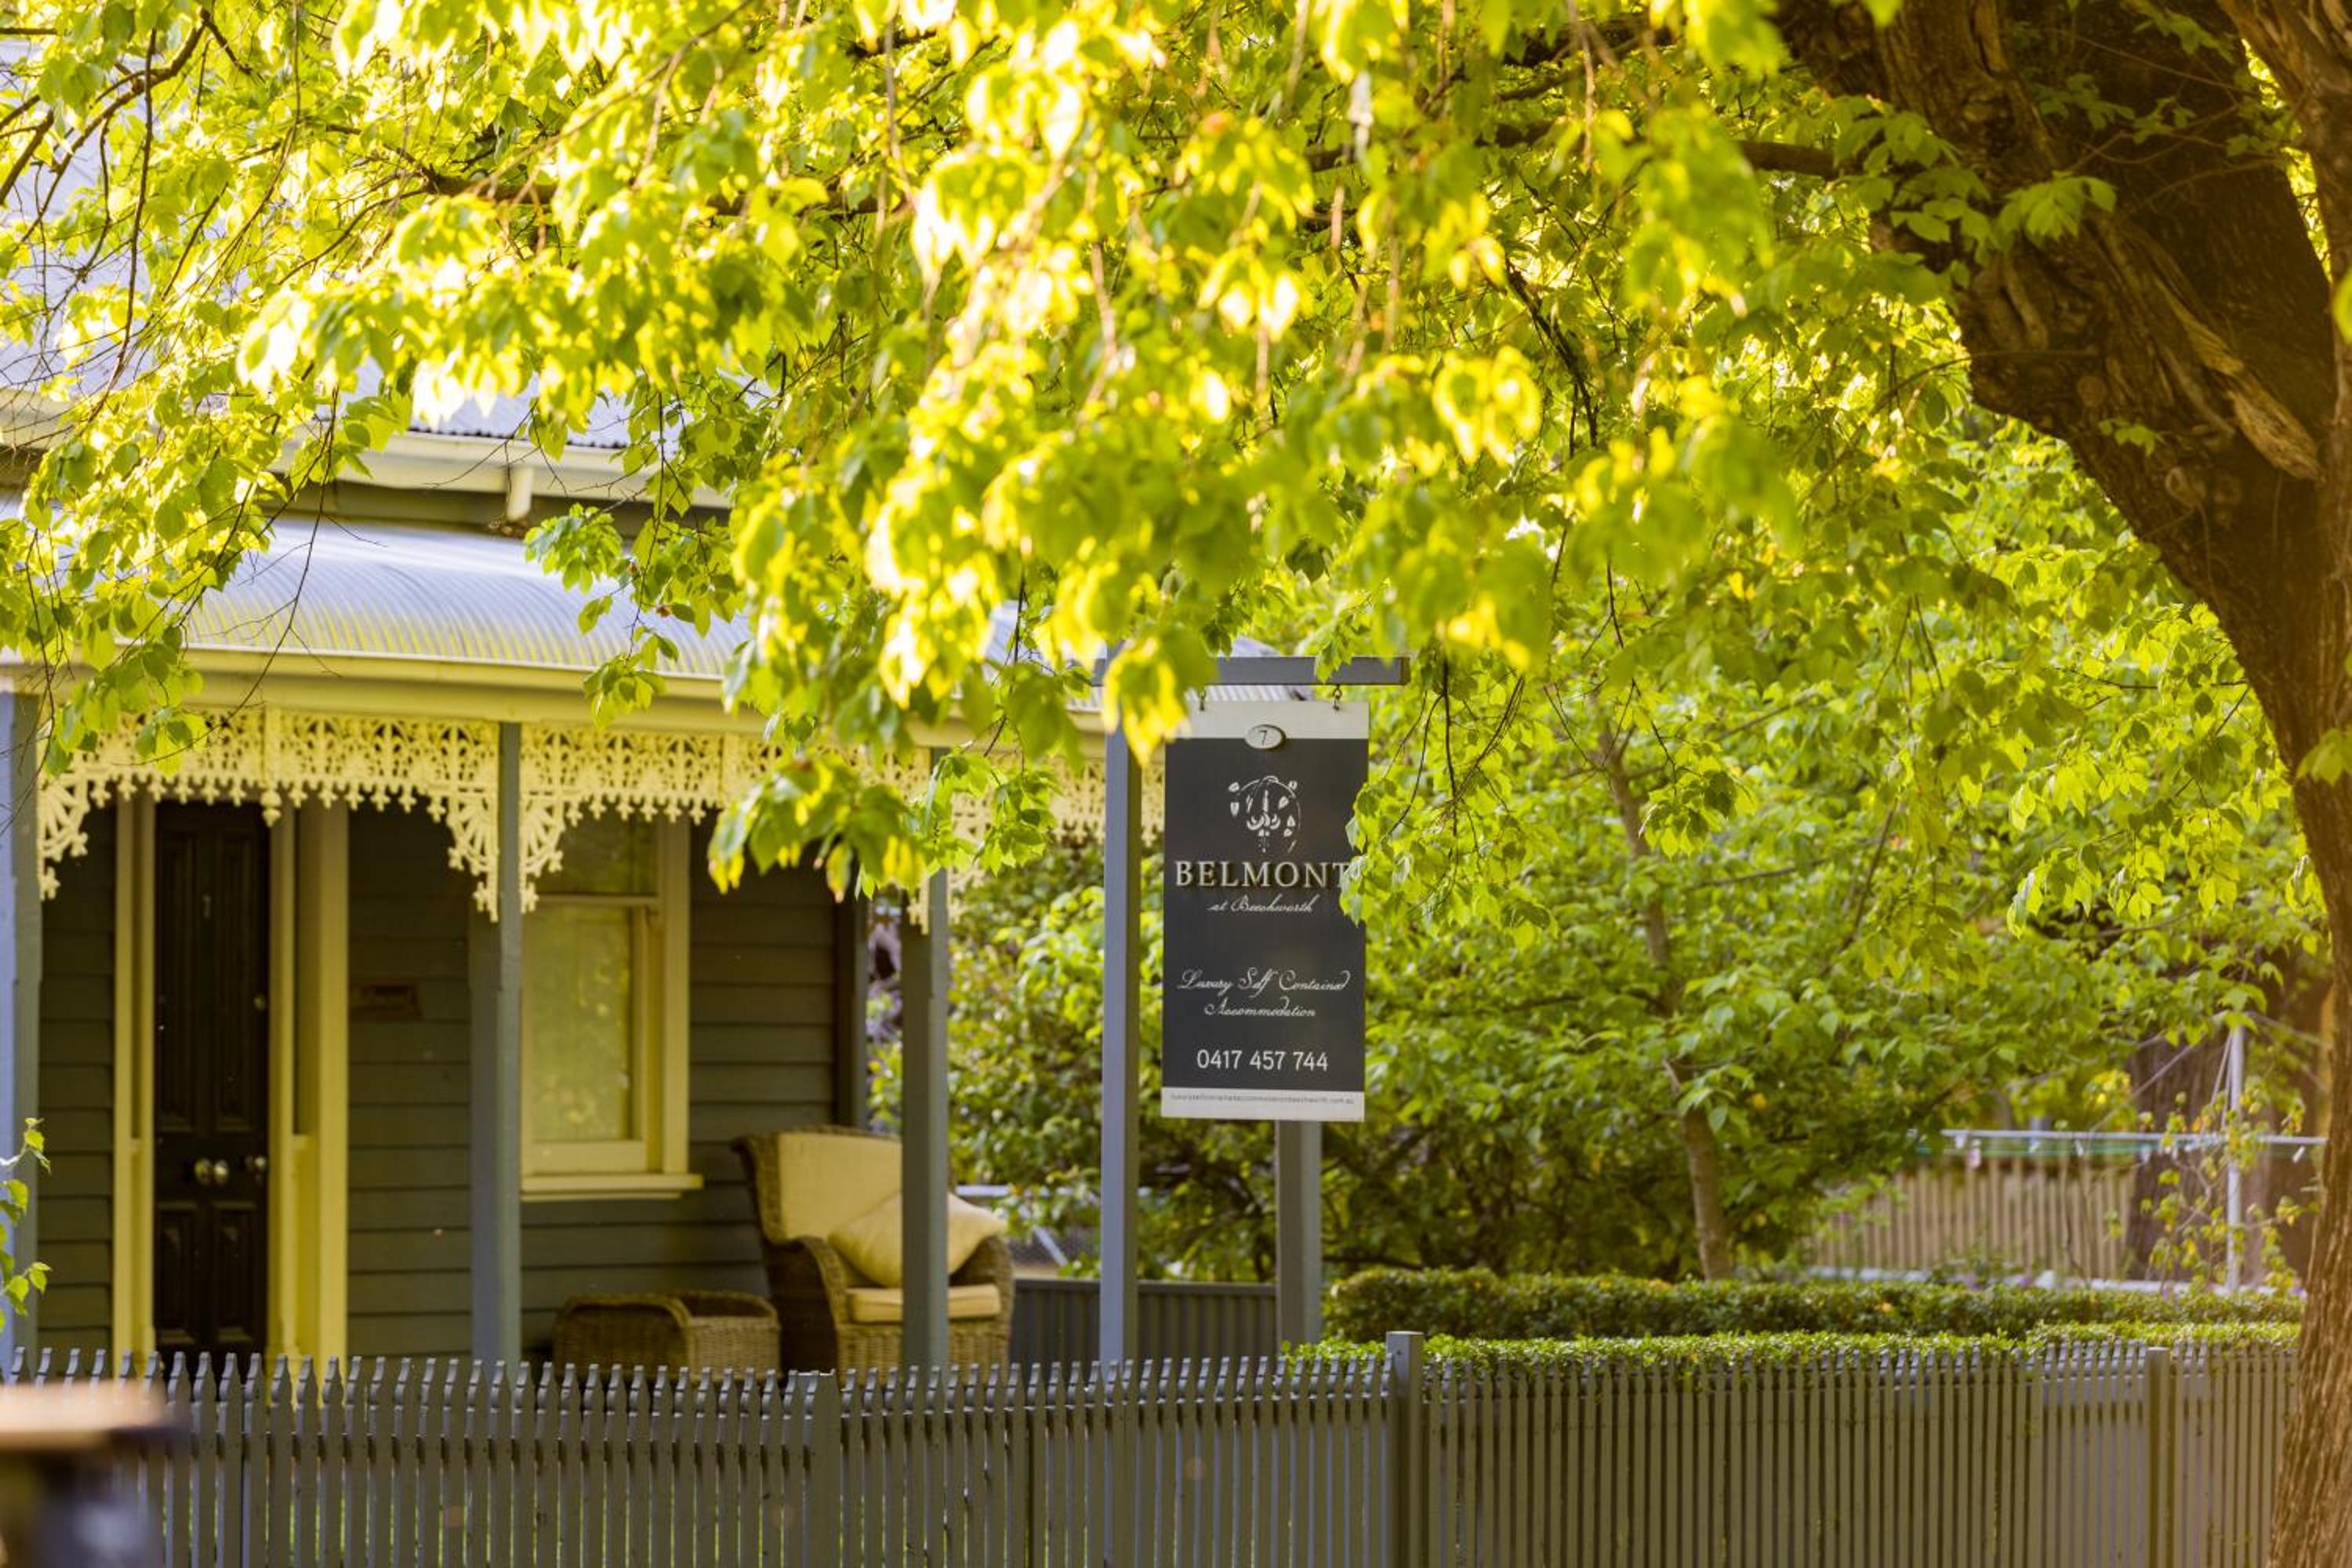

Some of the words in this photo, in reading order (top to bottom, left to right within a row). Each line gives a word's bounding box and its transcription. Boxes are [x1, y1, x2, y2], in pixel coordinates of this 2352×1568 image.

[1258, 730, 1268, 746] 7
[1175, 861, 1352, 888] BELMONT
[1207, 901, 1229, 912] at
[1230, 894, 1320, 912] Beechworth
[1177, 968, 1233, 996] Luxury
[1237, 967, 1278, 998] Self
[1279, 970, 1351, 991] Contained
[1203, 996, 1316, 1017] Accommodation
[1196, 1049, 1243, 1069] 0417
[1249, 1051, 1287, 1070] 457
[1293, 1051, 1330, 1072] 744
